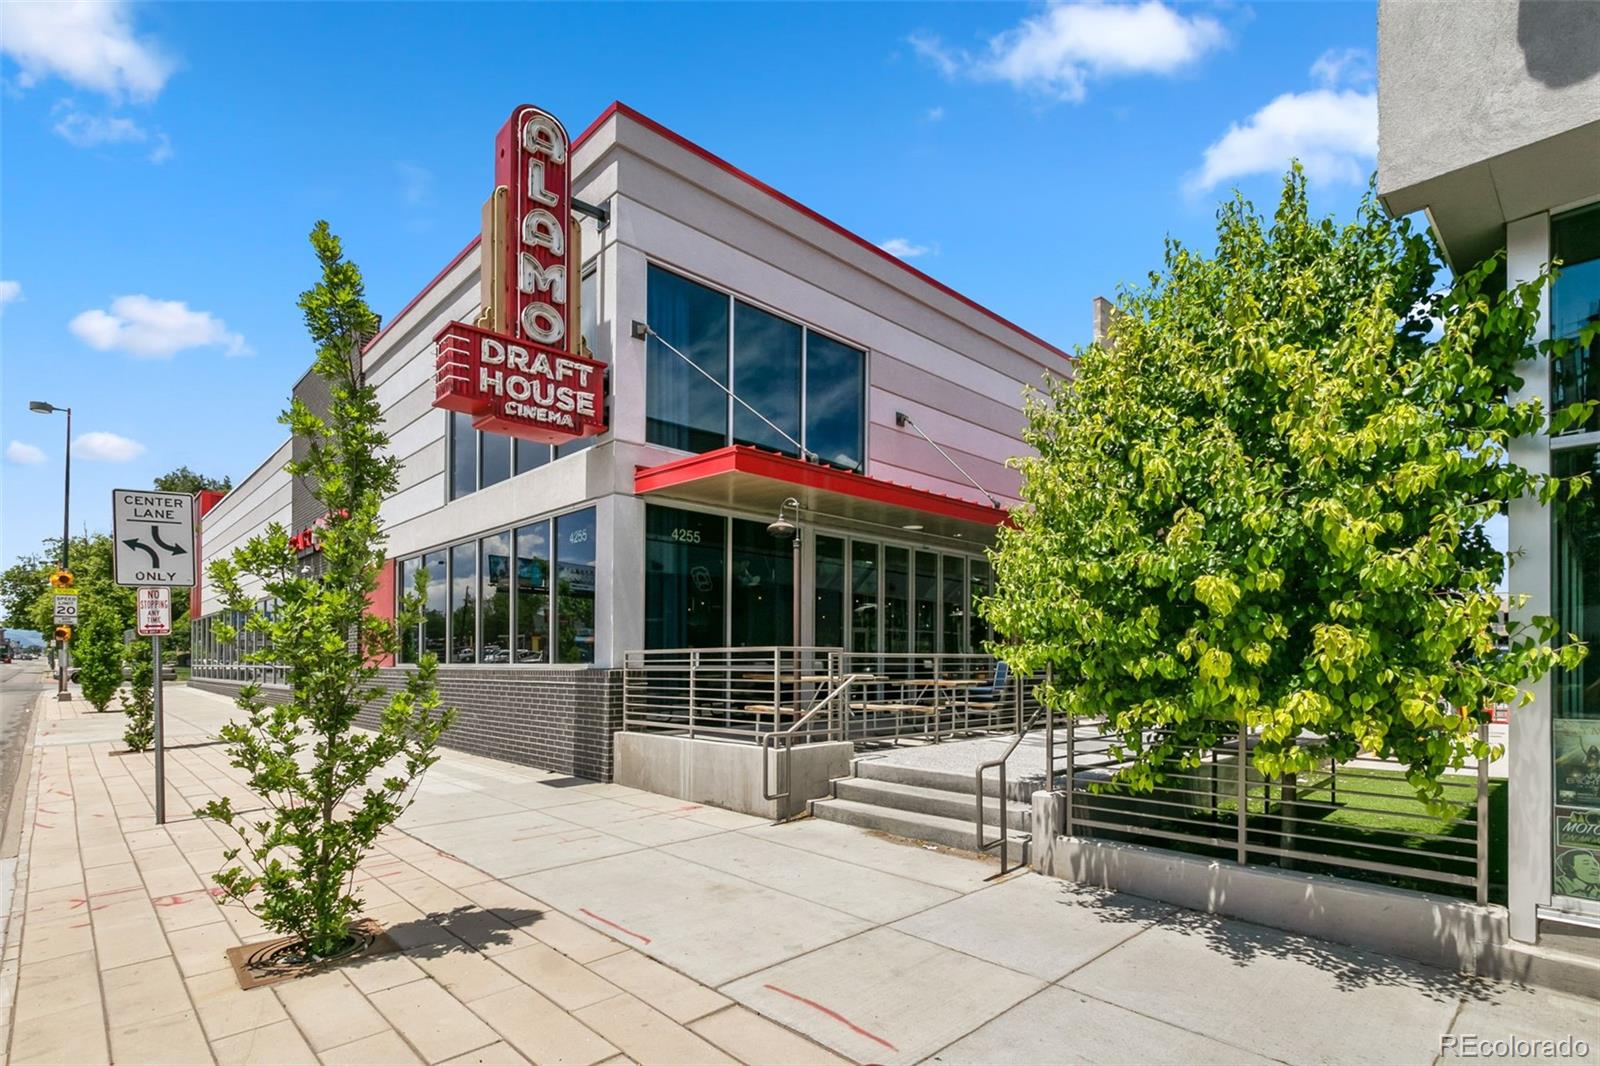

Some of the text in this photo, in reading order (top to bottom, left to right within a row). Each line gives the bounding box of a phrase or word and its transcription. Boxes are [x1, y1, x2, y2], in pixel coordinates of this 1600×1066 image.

[520, 115, 567, 344] ALAMO
[481, 338, 594, 387] DRAFT
[480, 367, 595, 417] HOUSE
[505, 401, 574, 427] CINEMA
[124, 495, 183, 508] CENTER
[134, 508, 175, 519] LANE
[671, 528, 701, 544] 4255
[135, 571, 177, 581] ONLY
[147, 590, 160, 599] NO
[57, 605, 76, 615] 20
[140, 599, 168, 609] STOPPING
